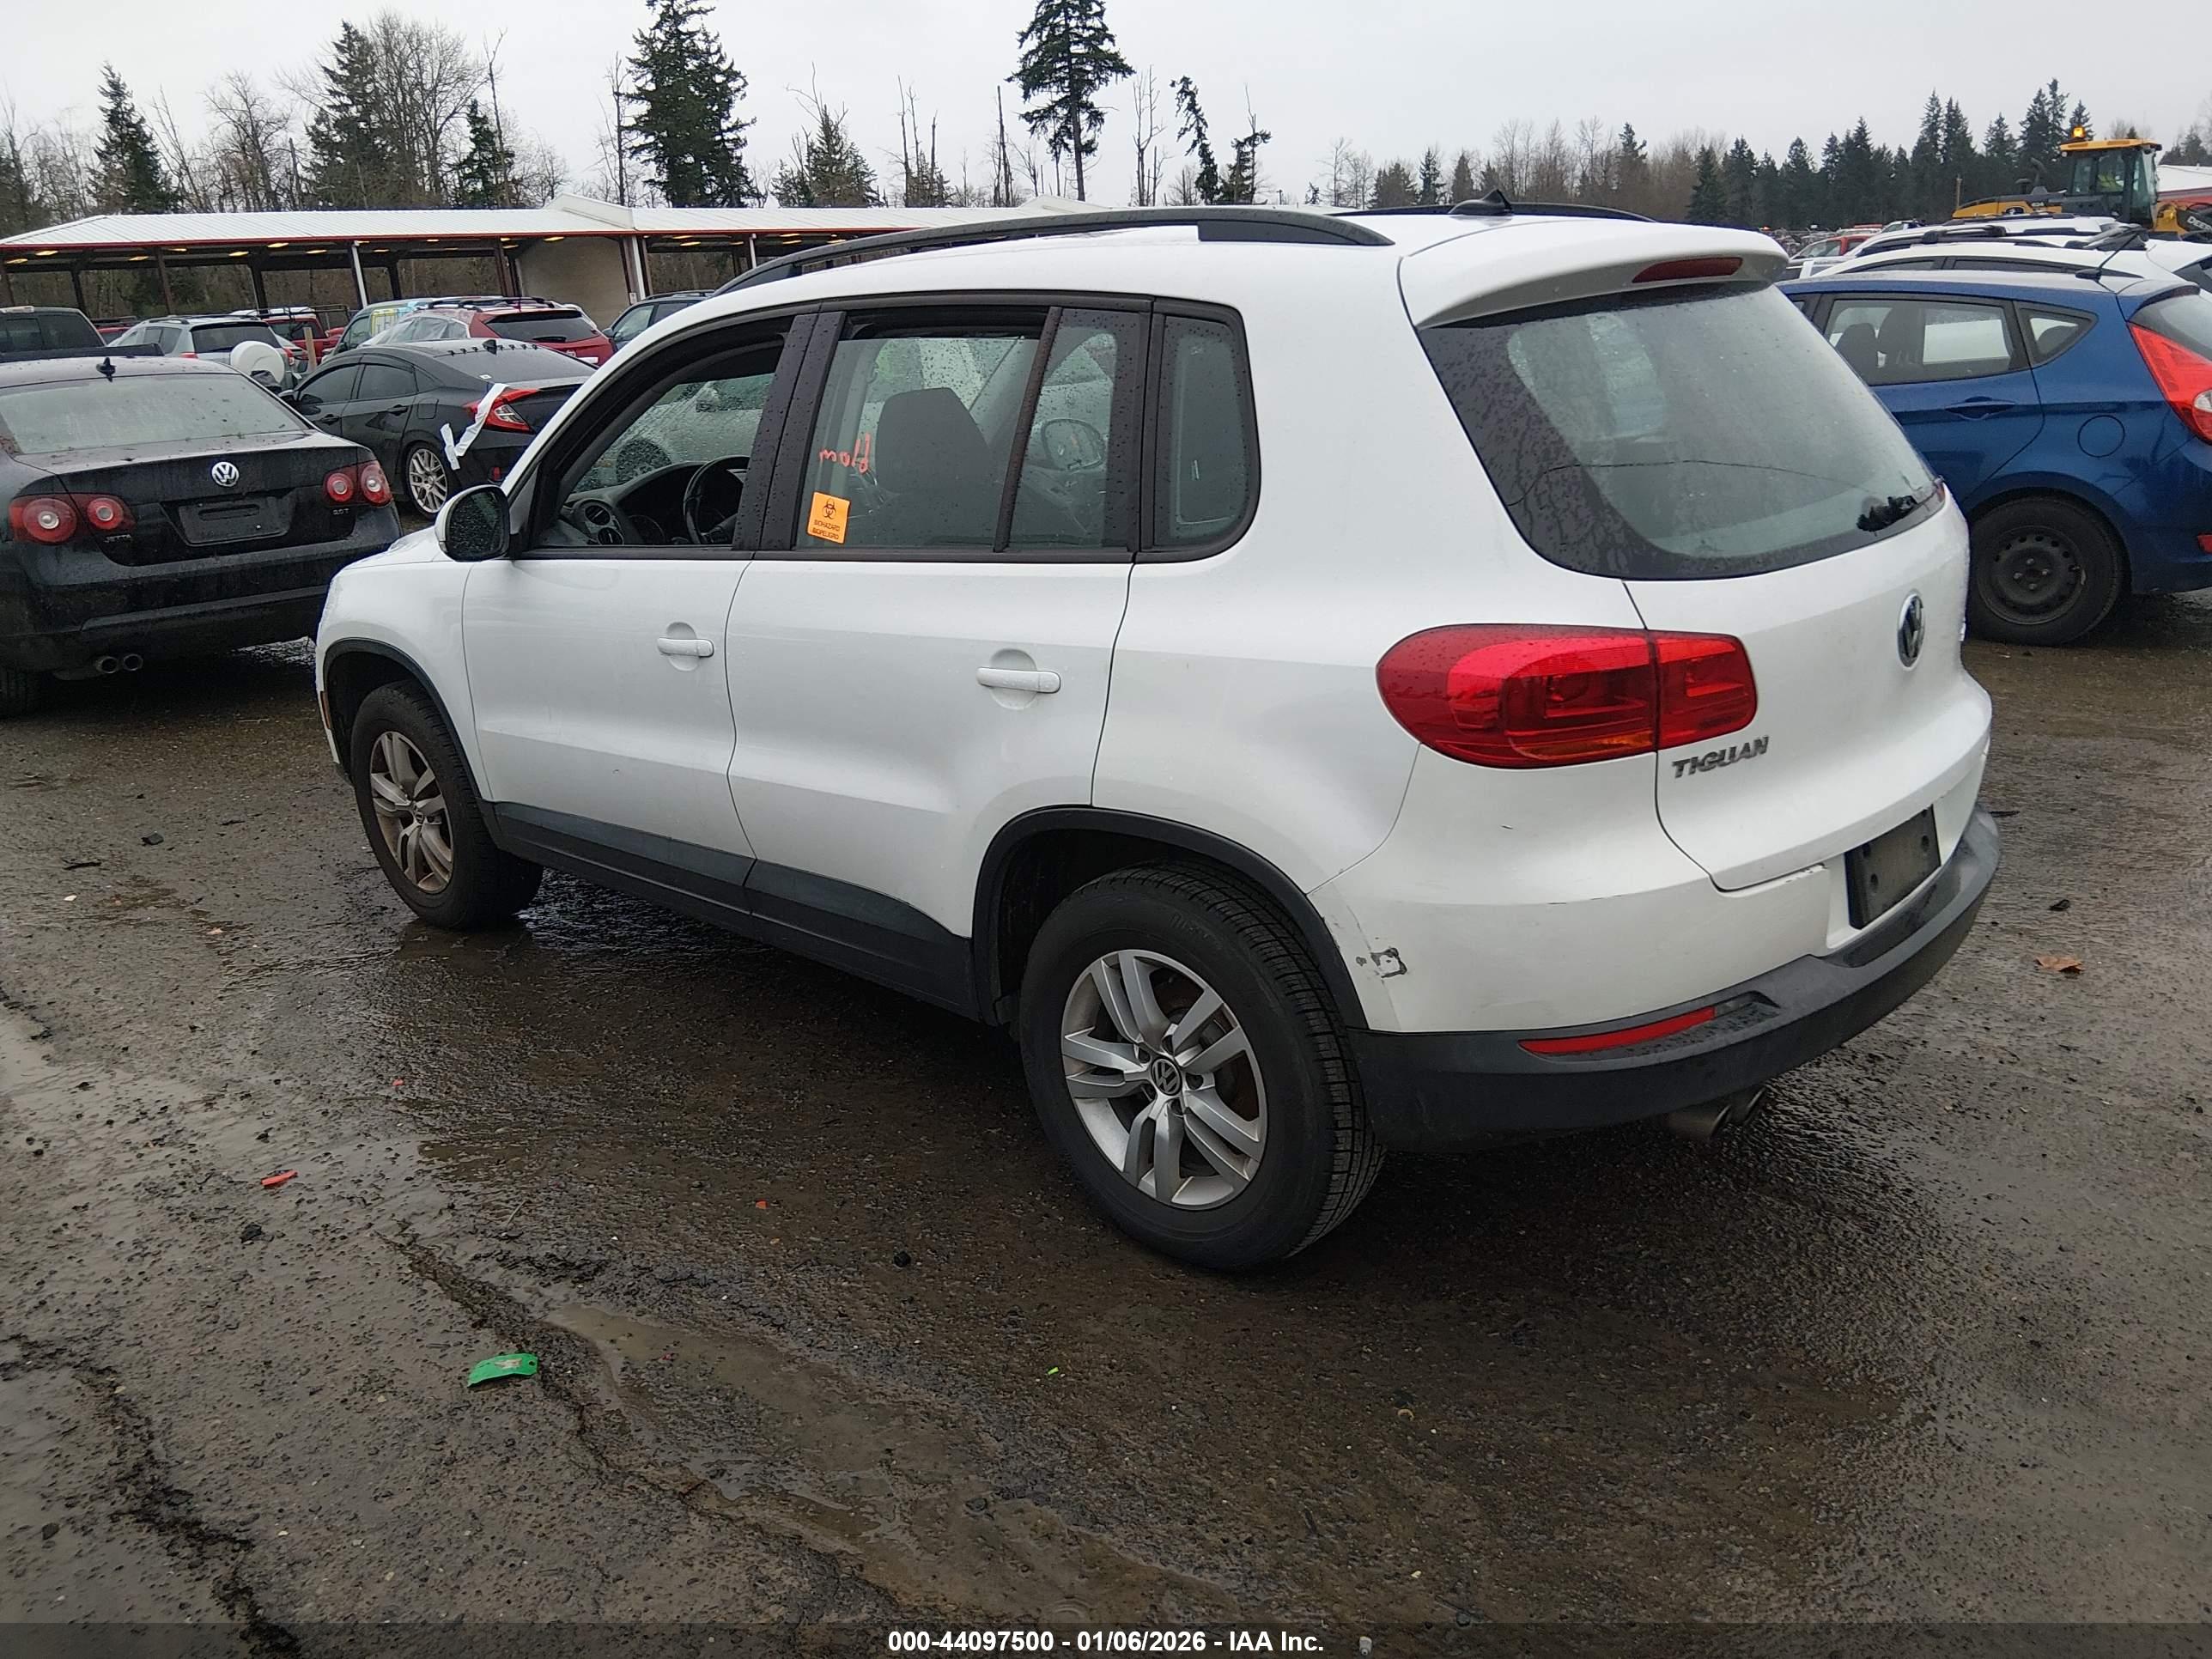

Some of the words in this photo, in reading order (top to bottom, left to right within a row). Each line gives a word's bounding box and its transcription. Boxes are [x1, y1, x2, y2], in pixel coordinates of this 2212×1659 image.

[814, 519, 841, 532] BIOHAZARD
[812, 527, 840, 540] BIOPELIGRO
[1672, 736, 1769, 779] TIGUAN
